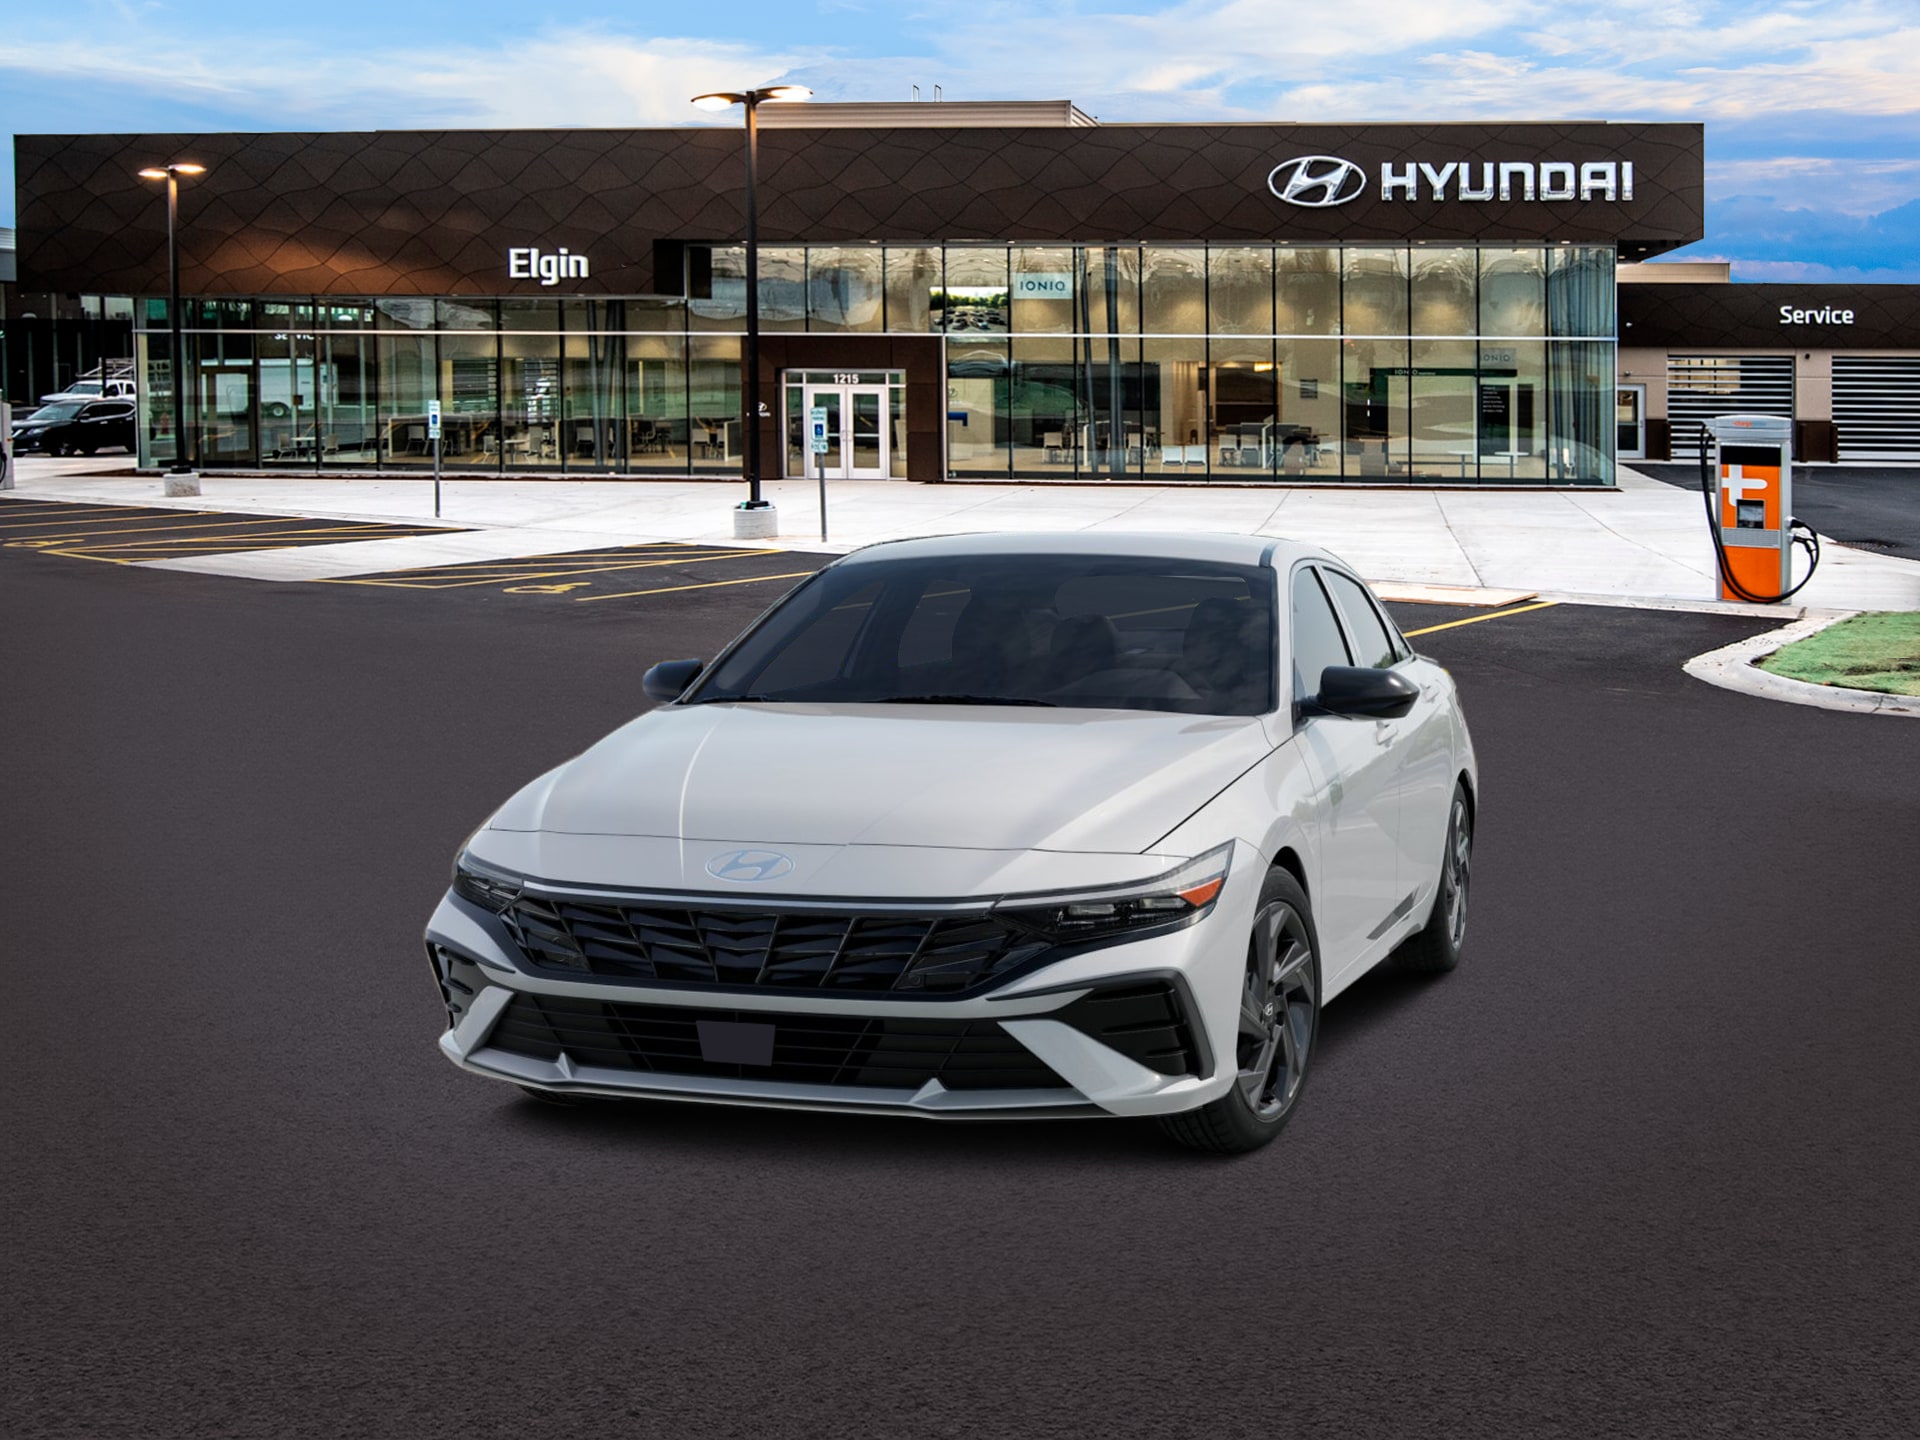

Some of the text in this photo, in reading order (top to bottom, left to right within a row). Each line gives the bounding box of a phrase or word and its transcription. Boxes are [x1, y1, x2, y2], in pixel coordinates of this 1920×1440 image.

[1381, 161, 1634, 201] HYUNDAI
[508, 247, 590, 286] Elgin
[1020, 280, 1066, 291] IONIQ
[1779, 305, 1855, 324] Service
[833, 373, 859, 384] 1215
